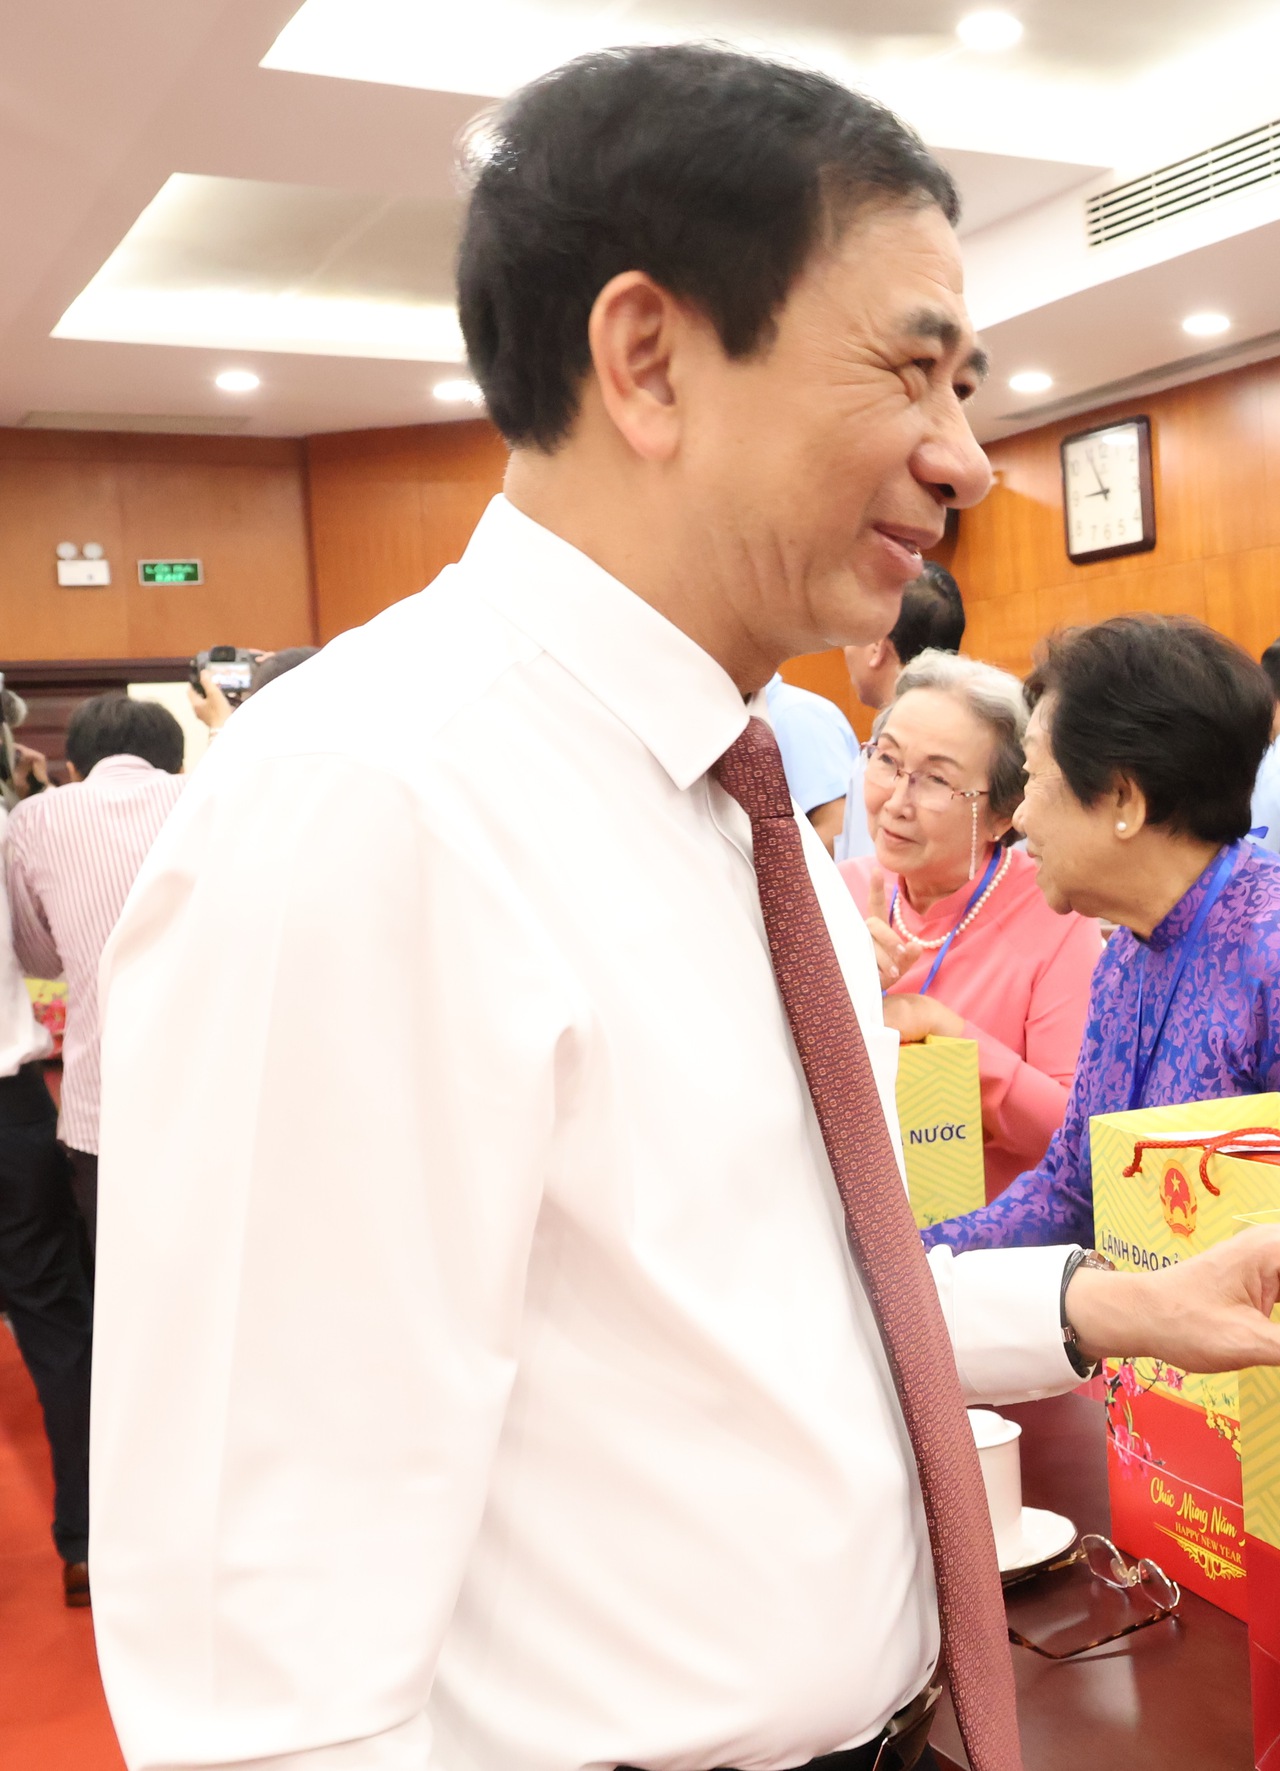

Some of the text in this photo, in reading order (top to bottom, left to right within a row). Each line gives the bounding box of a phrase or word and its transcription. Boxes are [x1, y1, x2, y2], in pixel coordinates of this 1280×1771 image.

[909, 1122, 967, 1145] NƯỚC
[1211, 1506, 1238, 1538] Năm
[1175, 1521, 1242, 1565] HAPPY NEW YEAR
